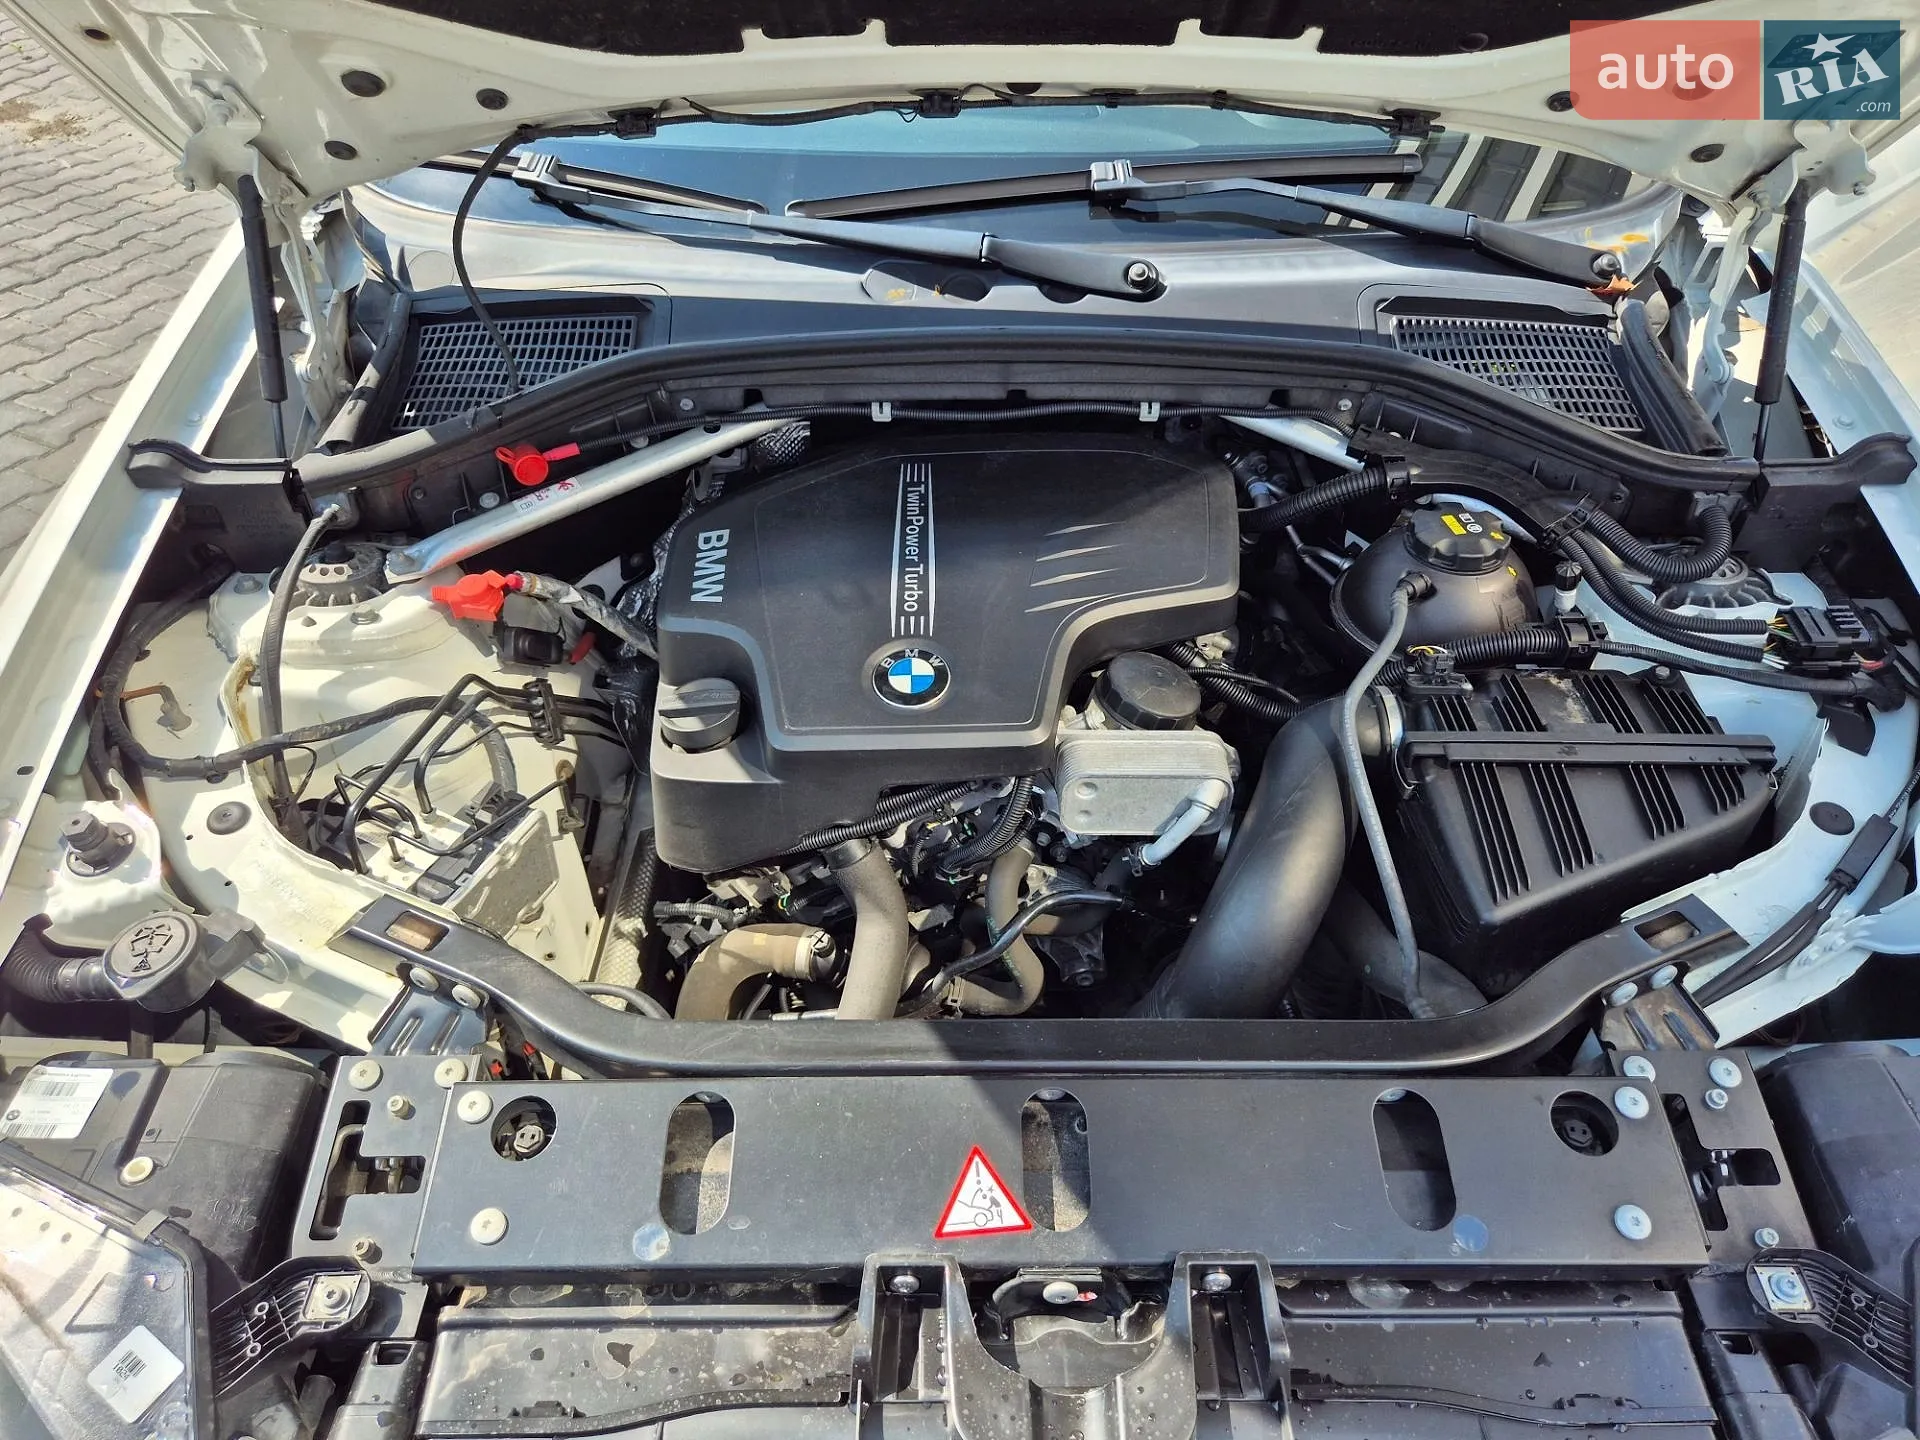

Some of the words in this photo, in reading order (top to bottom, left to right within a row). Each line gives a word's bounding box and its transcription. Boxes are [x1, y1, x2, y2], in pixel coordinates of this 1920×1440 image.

[905, 484, 925, 562] TwinPower
[690, 529, 730, 602] BMW
[903, 563, 924, 612] Turbo
[881, 649, 945, 669] BMW
